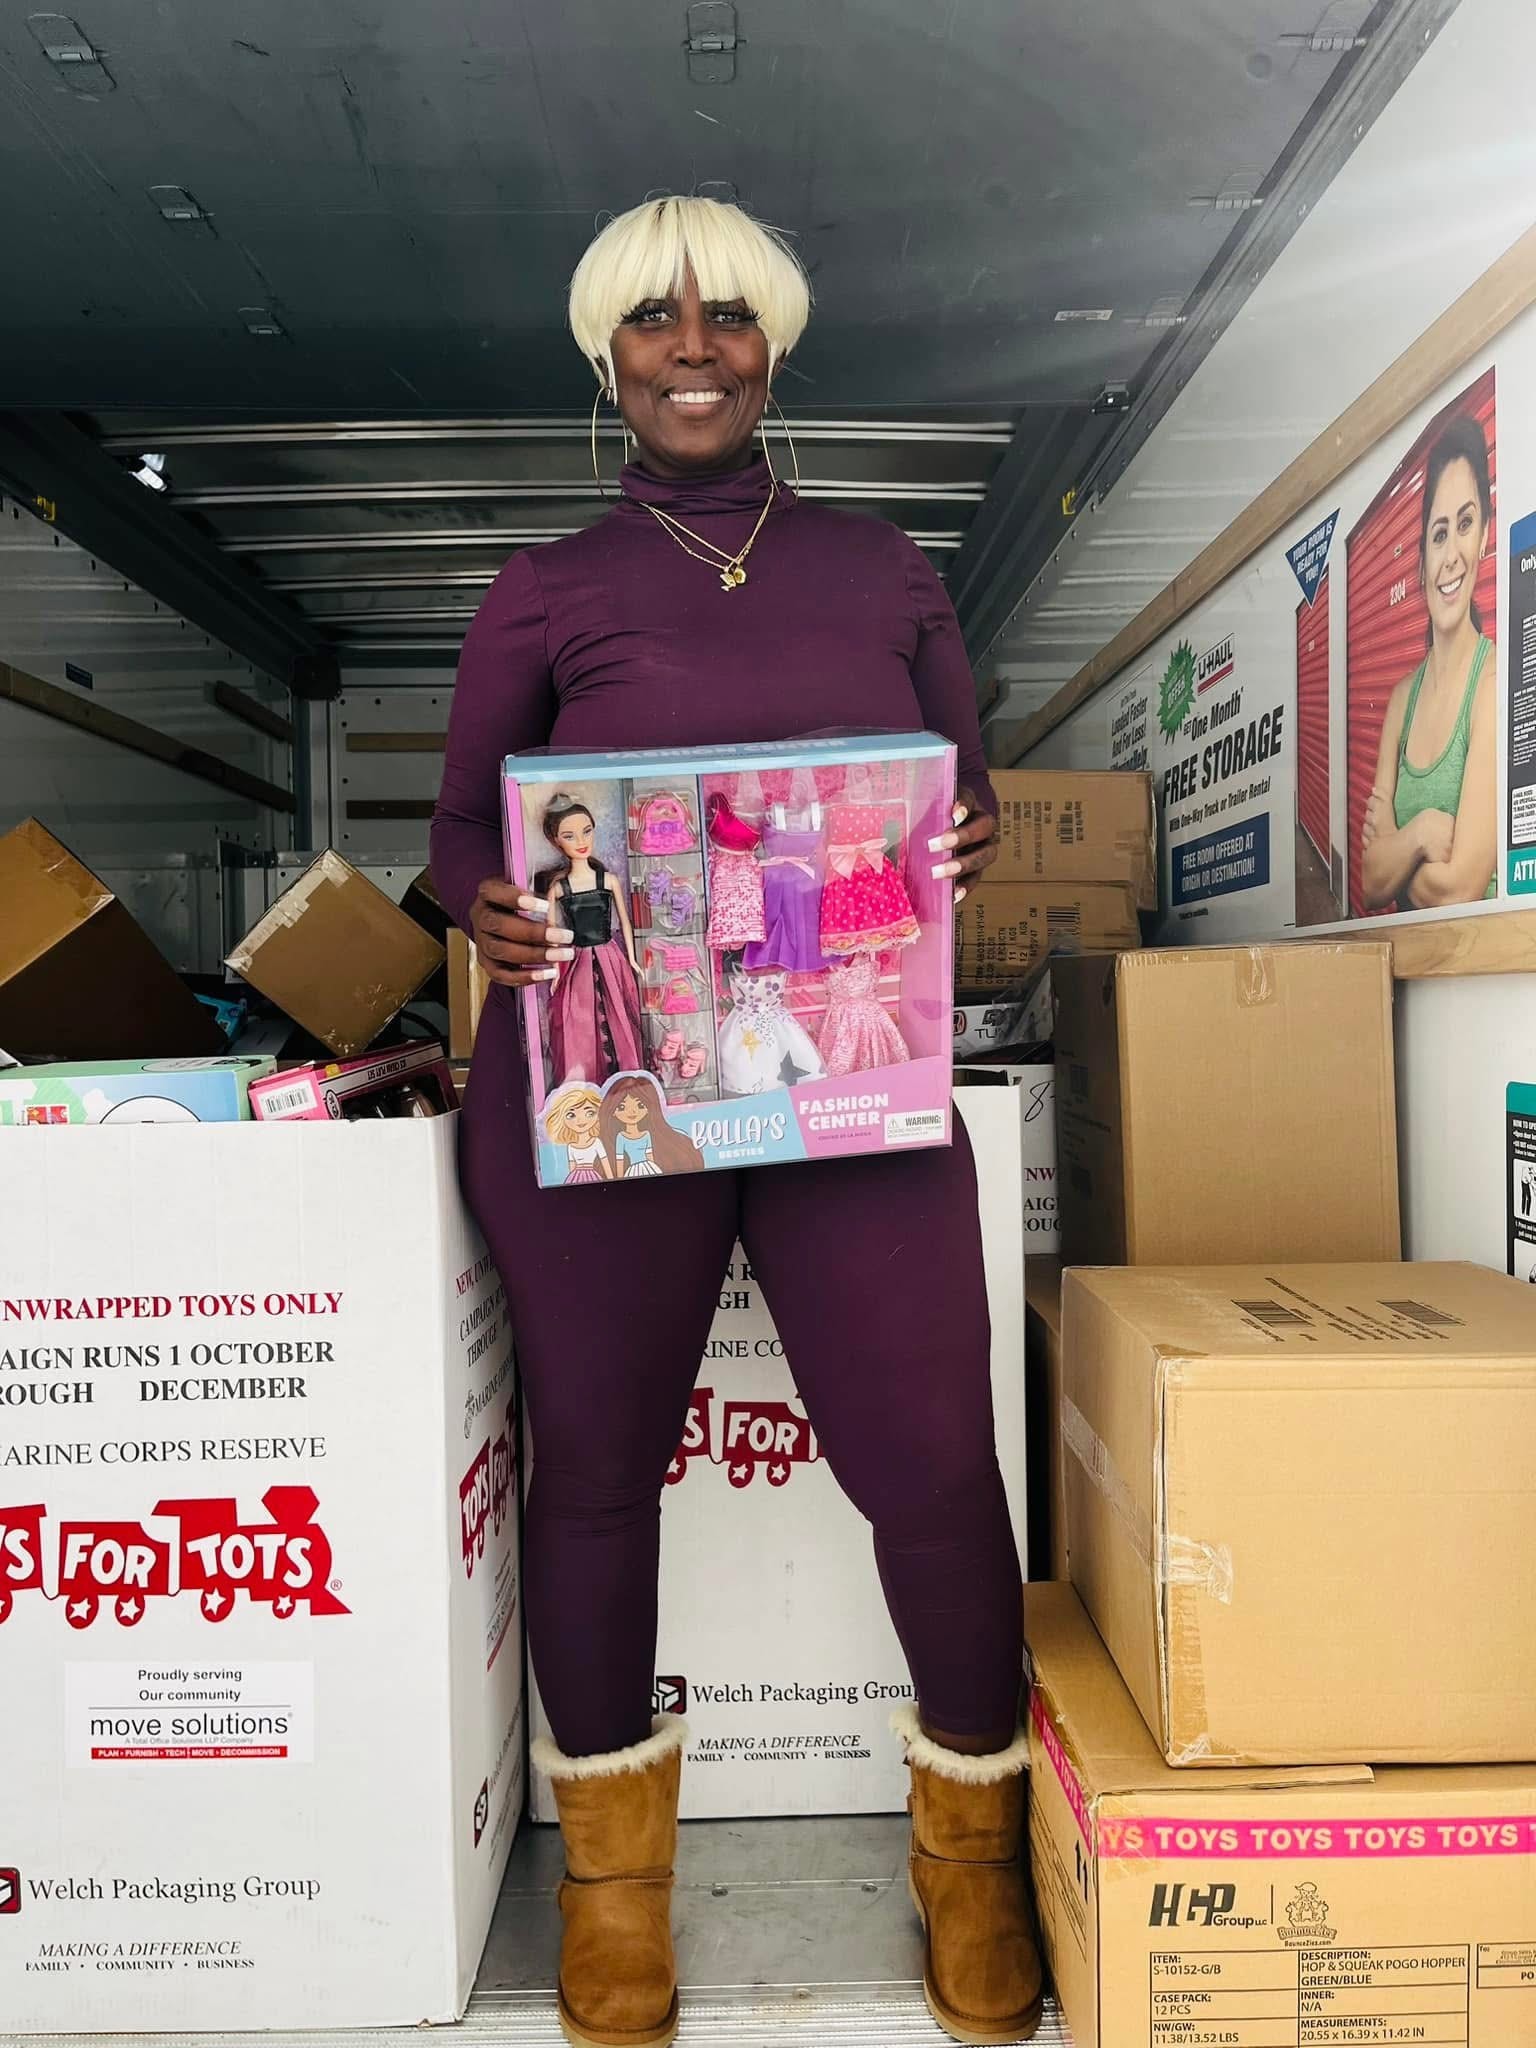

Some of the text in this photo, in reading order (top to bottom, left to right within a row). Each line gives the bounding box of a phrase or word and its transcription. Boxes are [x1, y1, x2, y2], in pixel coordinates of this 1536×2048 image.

[1198, 640, 1233, 680] U-HAUL
[1192, 717, 1209, 741] One
[1163, 704, 1284, 808] FREE STORAGE
[1182, 831, 1255, 872] FREE ROOM OFFERED AT
[1202, 870, 1210, 887] OR
[799, 1093, 889, 1115] FASHION
[808, 1111, 881, 1131] CENTER
[905, 1115, 942, 1126] WARNING:
[719, 1146, 765, 1159] BESTIES
[1024, 1168, 1056, 1181] NW
[1024, 1197, 1059, 1211] AIG
[179, 1294, 256, 1317] TOYS
[264, 1292, 344, 1315] ONLY
[82, 1345, 161, 1368] RUNS
[169, 1344, 181, 1366] 1
[190, 1341, 336, 1365] OCTOBER
[139, 1376, 308, 1402] DECEMBER
[727, 1411, 800, 1456] FOR
[0, 1437, 327, 1466] ARINE CORPS RESERVE
[462, 1463, 488, 1540] TOYS
[63, 1531, 157, 1589] FOR
[186, 1531, 314, 1589] TOTS
[138, 1668, 242, 1683] Proudly serving
[139, 1687, 241, 1702] Our community
[692, 1684, 753, 1703] Welch
[760, 1682, 858, 1704] Packaging
[90, 1712, 288, 1736] move solutions
[132, 1737, 148, 1745] Total
[150, 1736, 170, 1745] Office
[171, 1736, 203, 1745] Solutions
[220, 1736, 253, 1745] Company
[698, 1734, 861, 1750] MAKING A DIFFERENCE
[98, 1747, 280, 1757] PLAN FURNISH TECH MOVE DECOMMISSION
[687, 1750, 871, 1762] FAMILY COMMUNITY BUSINESS
[1155, 1825, 1238, 1850] TOYS
[1250, 1826, 1333, 1850] TOYS
[1344, 1825, 1426, 1850] TOYS
[1437, 1823, 1518, 1848] TOYS
[28, 1876, 321, 1903] Welch Packaging Group
[1213, 1914, 1254, 1928] Group
[38, 1941, 242, 1957] MAKING A DIFFERENCE
[1301, 1951, 1371, 1961] DESCRIPTION:
[25, 1959, 255, 1972] FAMILY COMMUNITY BUSINESS
[1153, 1955, 1181, 1964] ITEM:
[1301, 1957, 1465, 1972] HOP & SQUEAK POGO HOPPER
[1153, 1964, 1221, 1975] S-10152-G/B
[1301, 1975, 1372, 1986] GREEN/BLUE
[1154, 1994, 1211, 2003] CASE PACK:
[1301, 1991, 1335, 2000] INNER:
[1155, 2005, 1191, 2015] 12 PCS
[1301, 2002, 1322, 2012] N/A
[1153, 2023, 1195, 2032] NW/GW:
[1301, 2018, 1387, 2029] MEASUREMENTS:
[1155, 2032, 1239, 2044] 11.38/13.52 LBS
[1301, 2030, 1330, 2041] 20.55
[1342, 2029, 1370, 2040] 16.39
[1382, 2028, 1410, 2038] 11.42
[1413, 2027, 1424, 2037] IN
